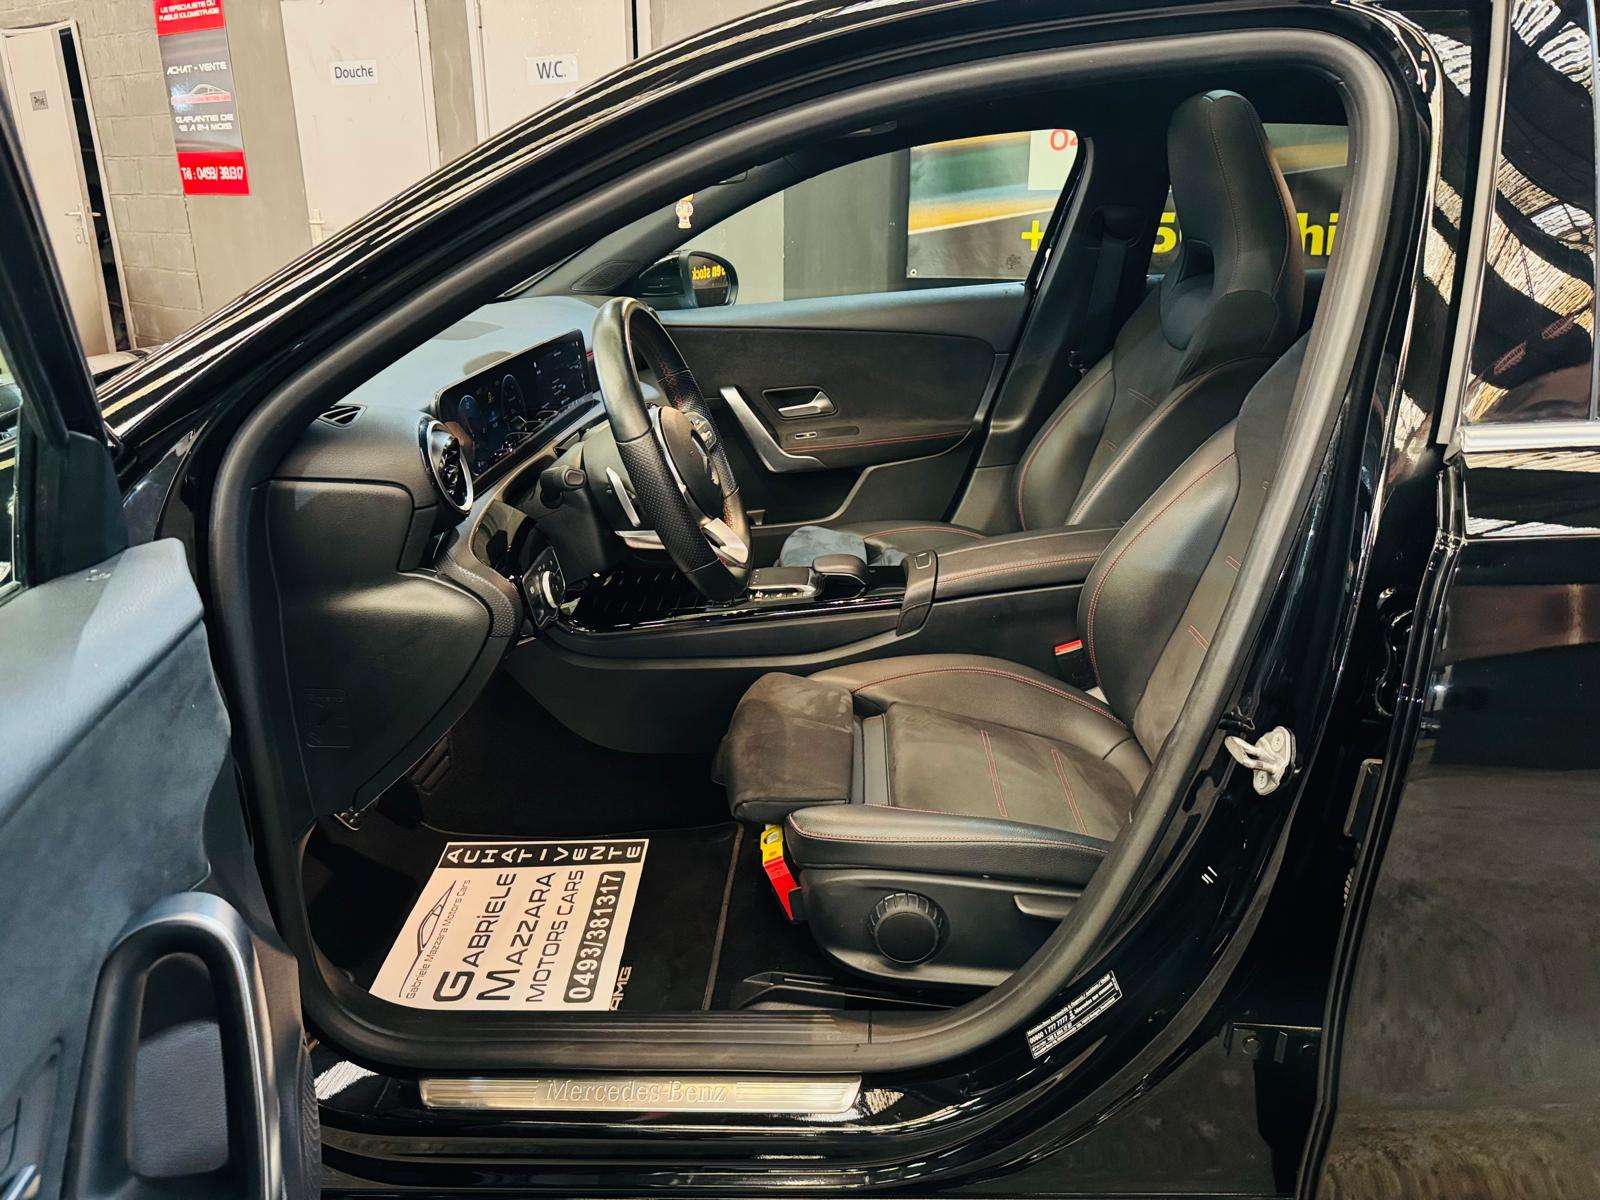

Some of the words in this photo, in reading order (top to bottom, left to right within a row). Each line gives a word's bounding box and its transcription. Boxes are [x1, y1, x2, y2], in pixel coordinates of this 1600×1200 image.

[334, 64, 374, 79] Douche
[536, 60, 567, 79] W.C.
[447, 848, 533, 864] ACHAT
[553, 846, 641, 863] VENTE
[475, 872, 557, 1001] MAZZARA
[525, 920, 569, 1002] MOTORS
[556, 870, 585, 916] CARS
[567, 873, 622, 1000] 0493/381317
[609, 965, 633, 1012] AMG
[546, 1079, 728, 1104] Mercedes-Benz
